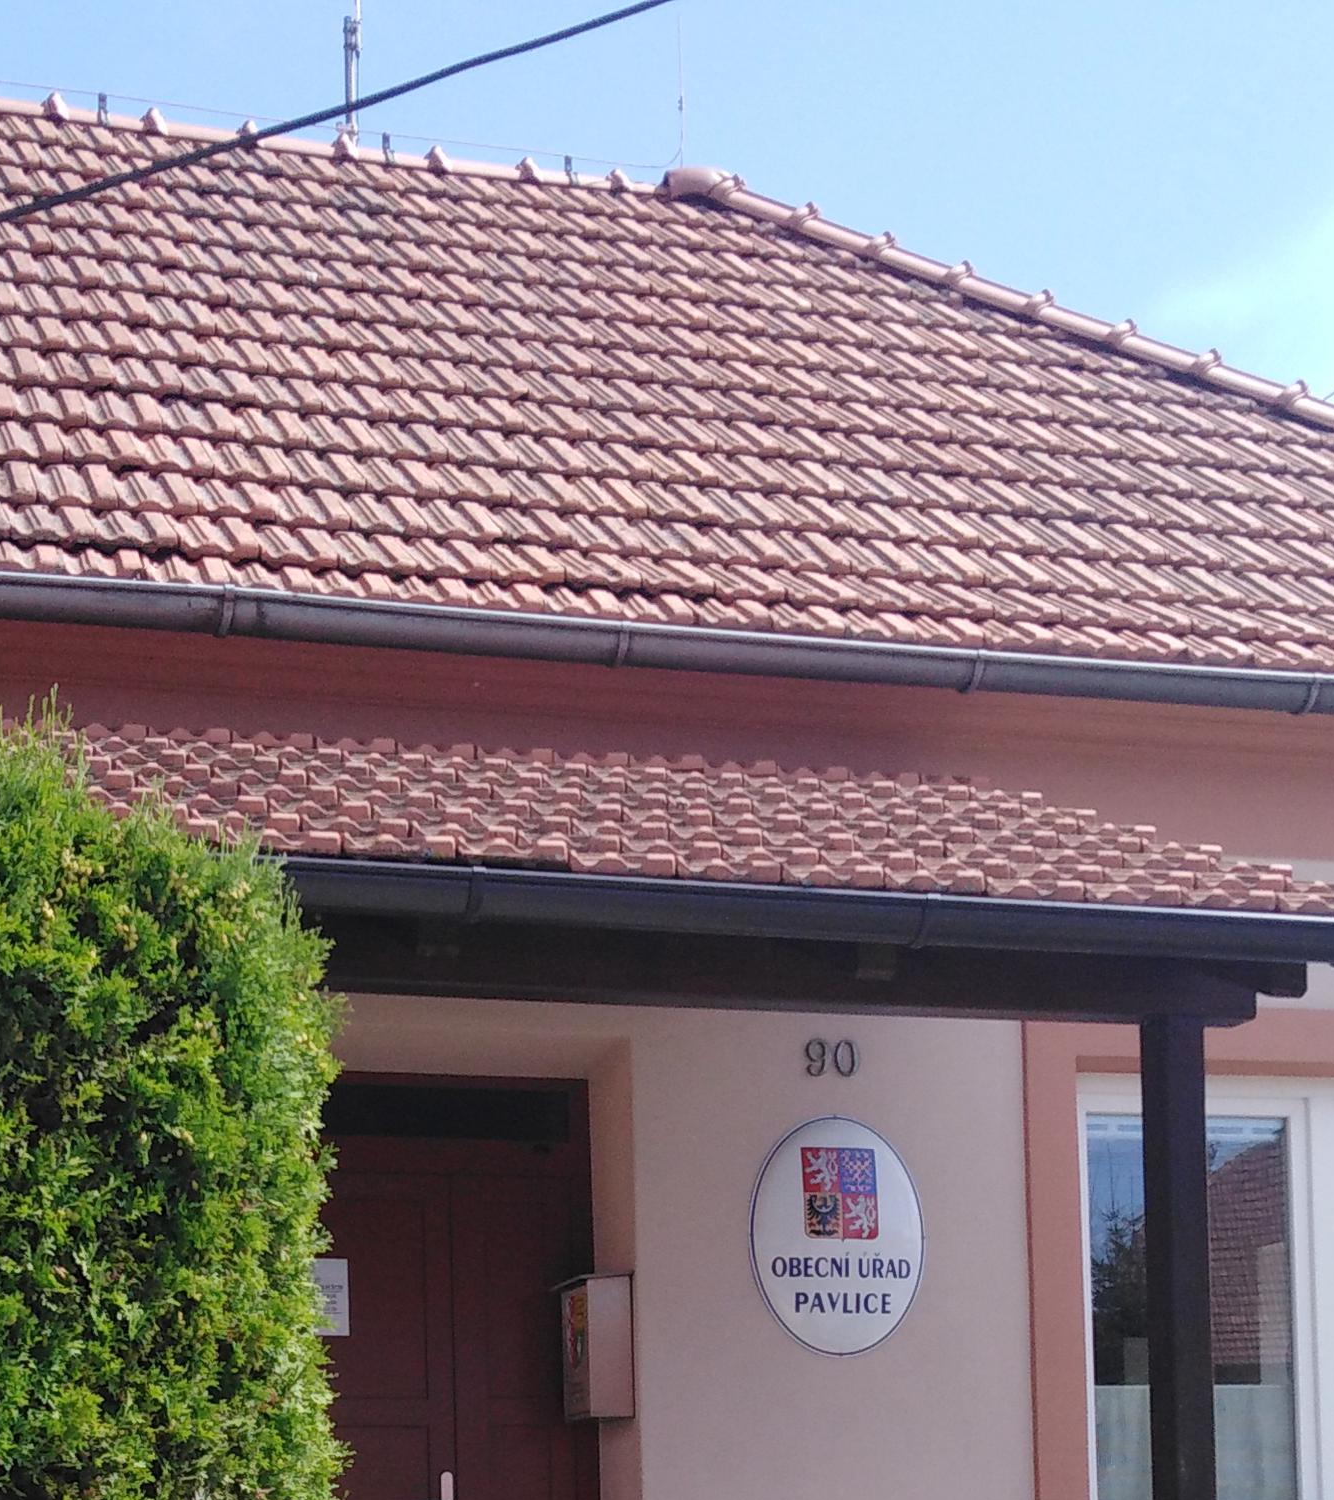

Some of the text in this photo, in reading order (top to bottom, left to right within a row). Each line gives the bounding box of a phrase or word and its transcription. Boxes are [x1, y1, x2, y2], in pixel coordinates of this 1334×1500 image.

[803, 1037, 857, 1077] 90
[771, 1252, 911, 1280] OBECNÍ ÚŘAD
[794, 1292, 892, 1315] PAVLICE
